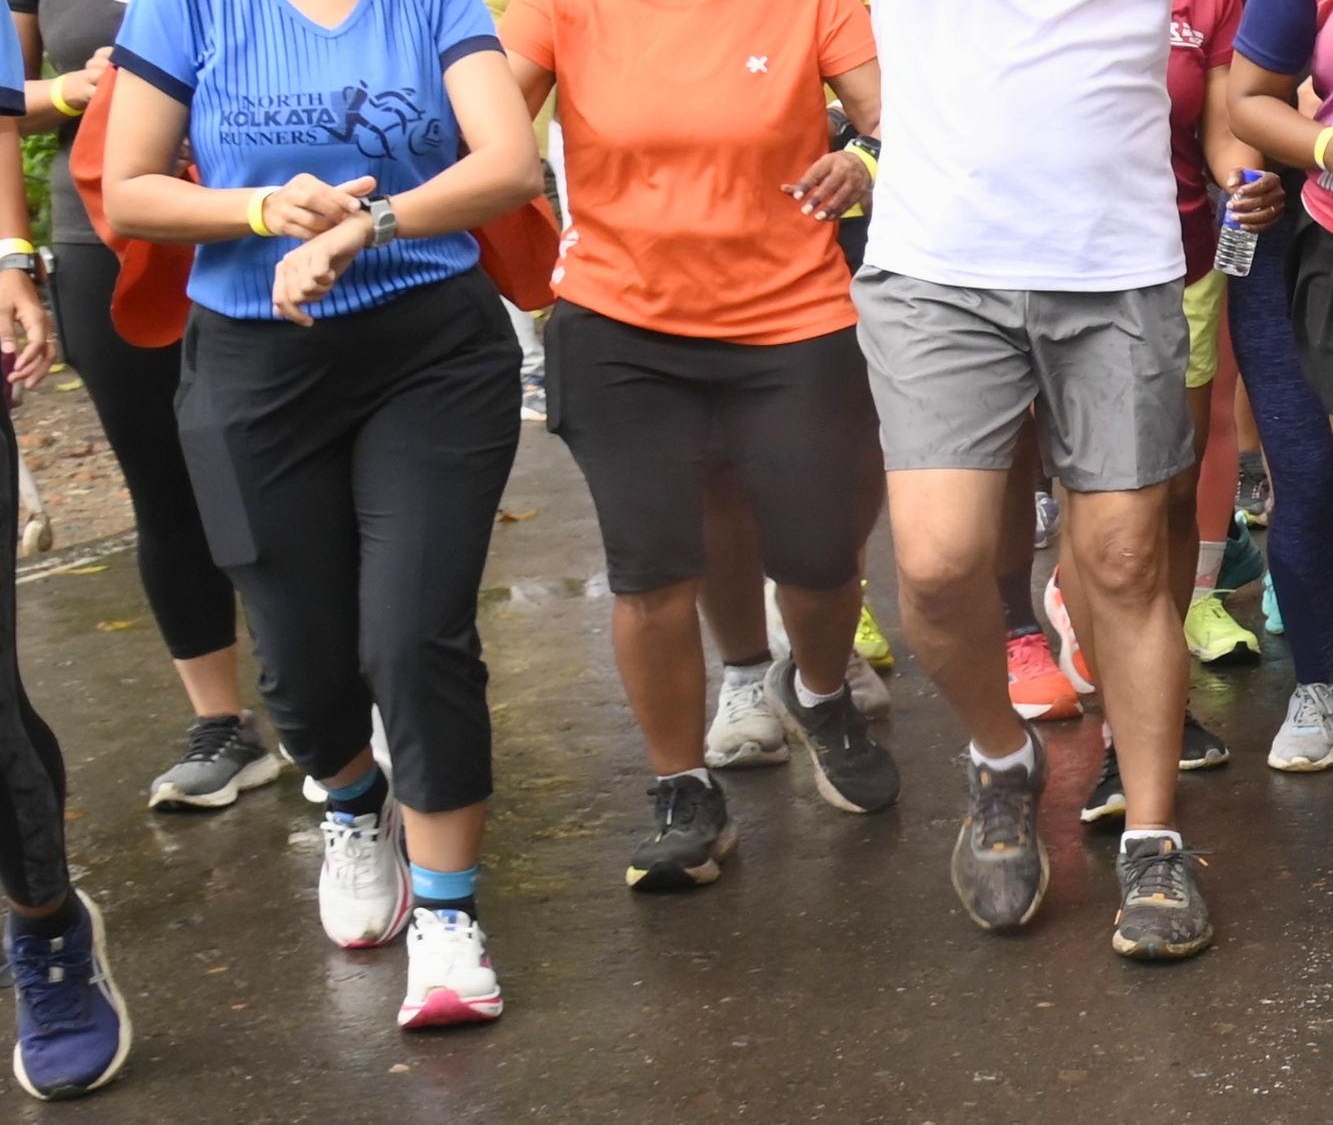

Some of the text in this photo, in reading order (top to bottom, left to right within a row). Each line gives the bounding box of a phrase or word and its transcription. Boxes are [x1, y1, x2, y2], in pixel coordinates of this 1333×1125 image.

[242, 92, 323, 109] NORTH
[221, 107, 336, 126] KOLKATA
[219, 130, 317, 146] RUNNERS
